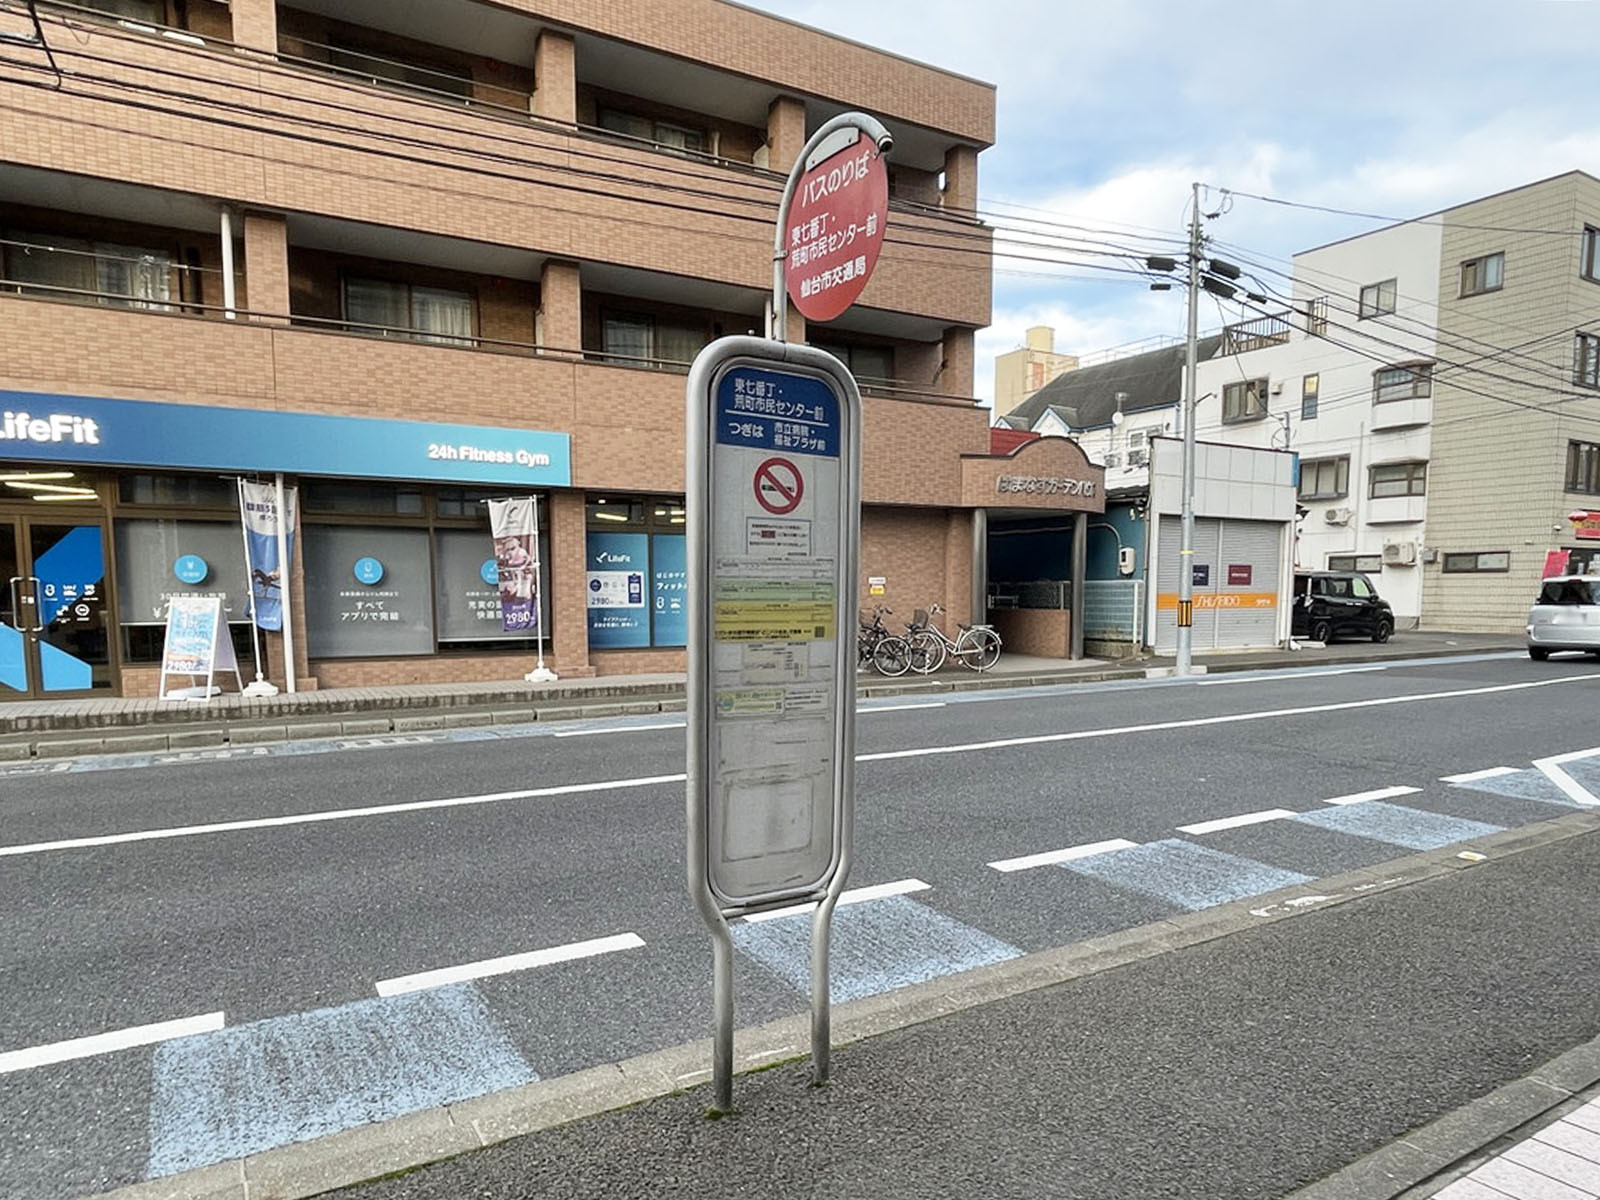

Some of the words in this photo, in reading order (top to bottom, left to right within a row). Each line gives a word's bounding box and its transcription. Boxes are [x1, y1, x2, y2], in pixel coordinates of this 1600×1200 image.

[801, 149, 870, 209] バスのりば
[790, 212, 878, 271] 荒町市民センター前
[800, 255, 867, 299] 仙台市交通局
[734, 394, 825, 421] 荒町市民センター前
[0, 411, 100, 445] ifeFit
[728, 422, 764, 438] つぎは
[428, 443, 457, 459] 24h
[459, 446, 514, 463] Fitness
[516, 450, 550, 467] Gym
[355, 601, 384, 610] すべて
